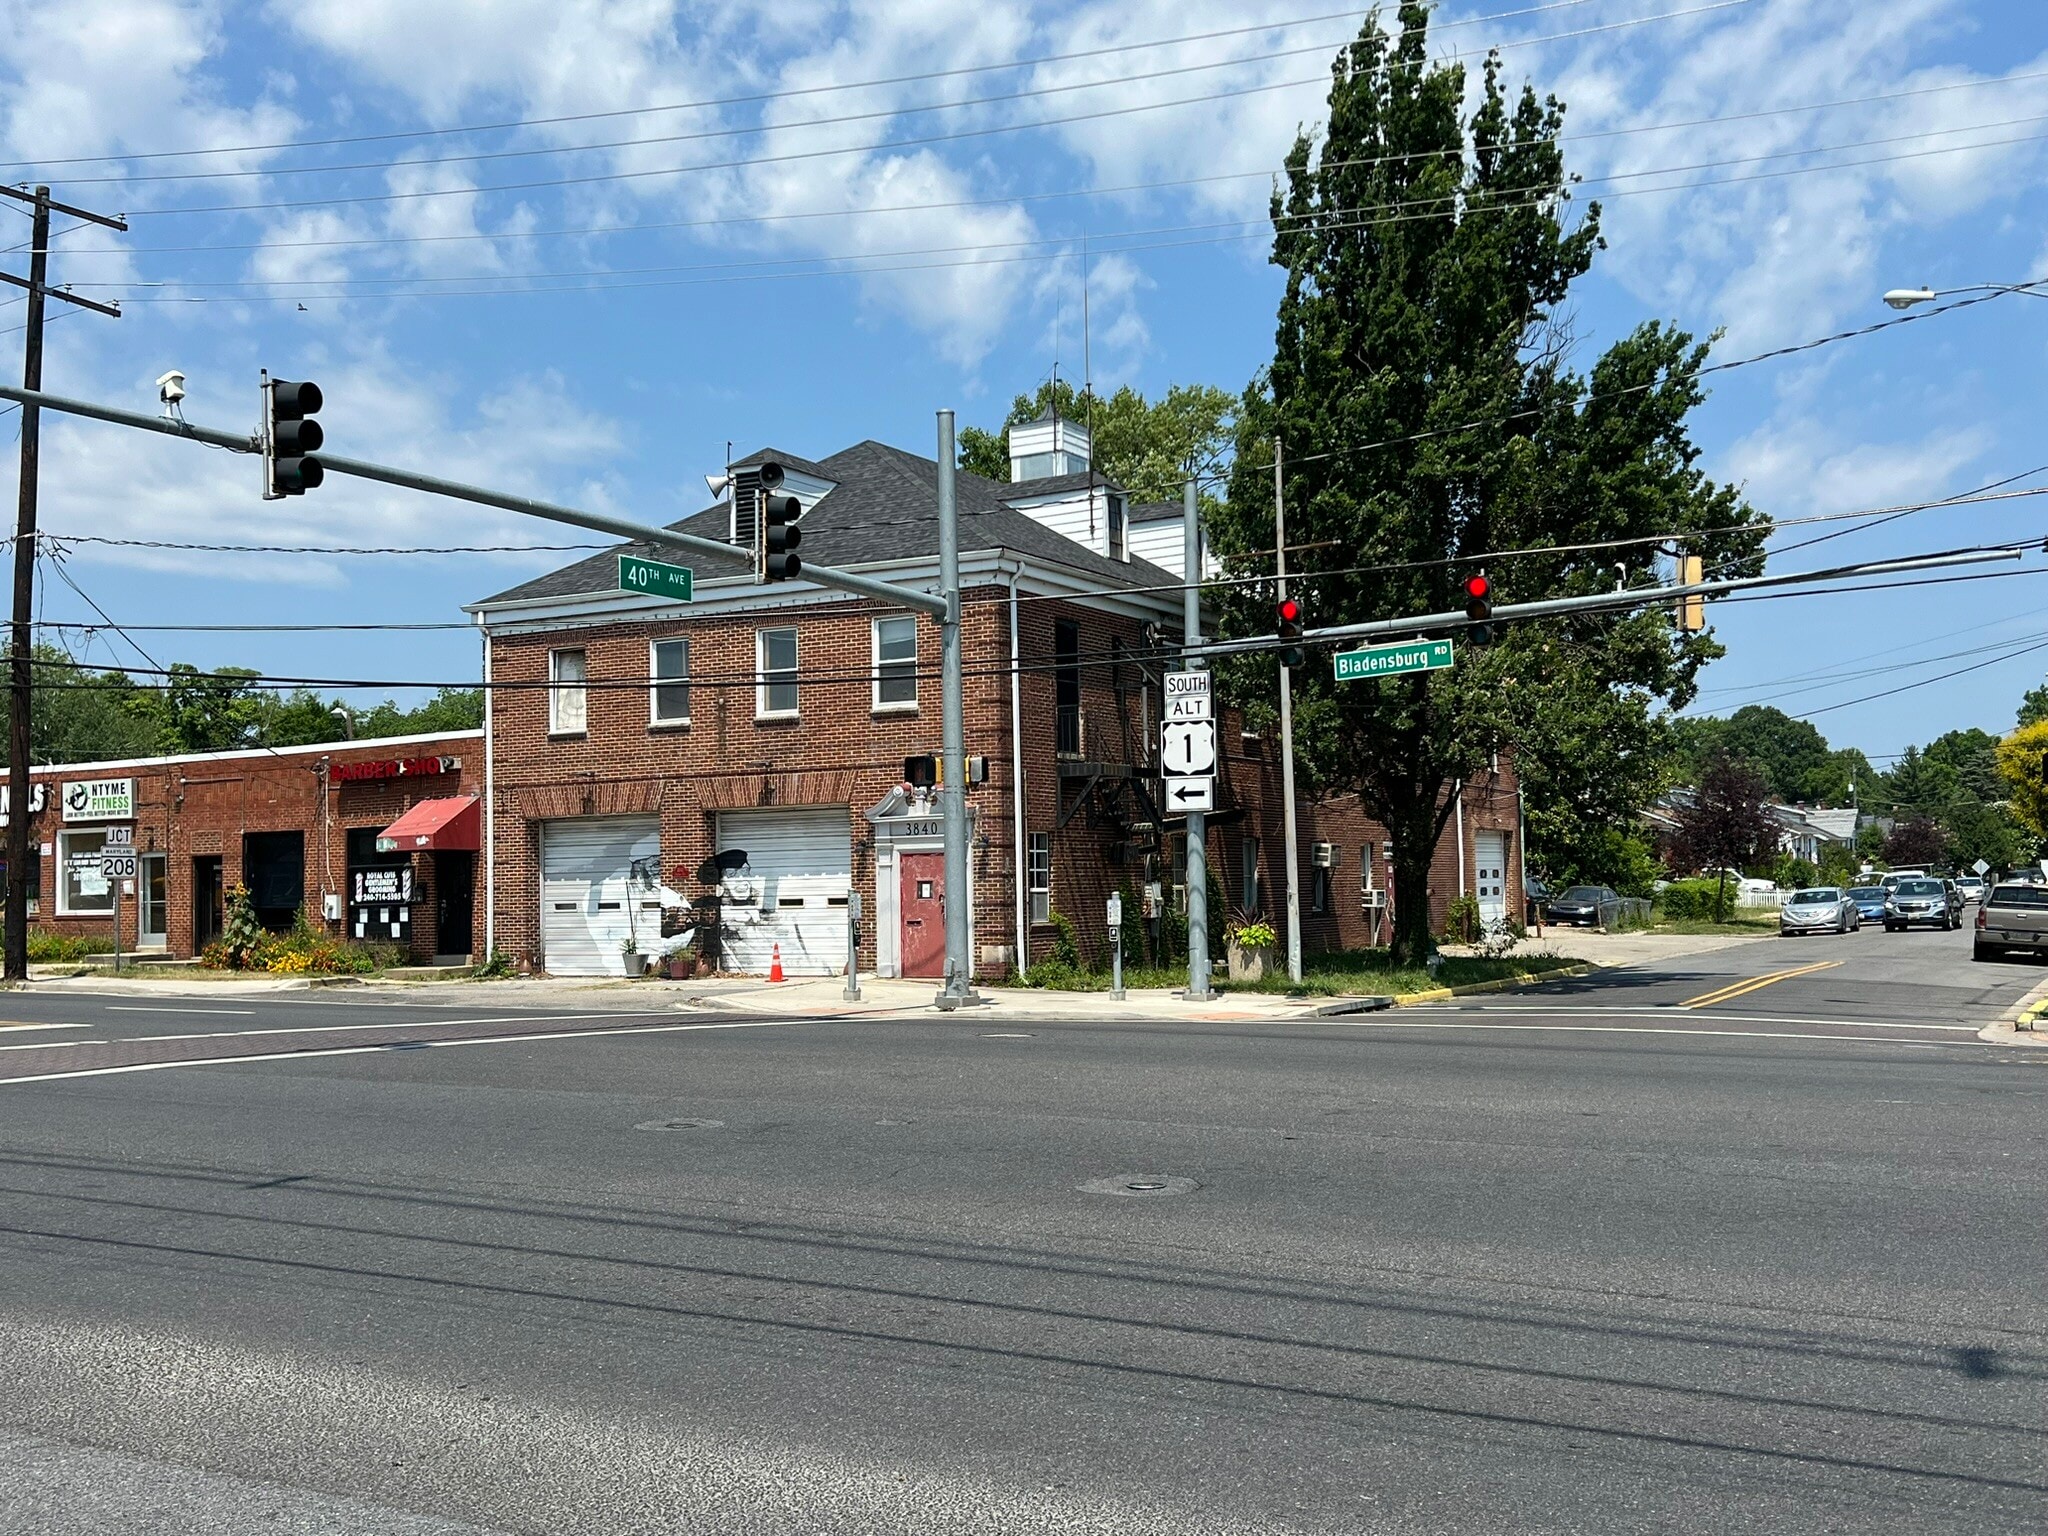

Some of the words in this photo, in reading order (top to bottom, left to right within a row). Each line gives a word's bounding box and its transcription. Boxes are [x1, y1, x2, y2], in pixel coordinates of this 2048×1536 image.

[628, 565, 660, 586] 40TH
[668, 572, 685, 585] AVE
[1339, 651, 1428, 669] Bladensburg
[1434, 645, 1448, 655] RD
[1168, 676, 1207, 692] SOUTH
[1173, 700, 1203, 715] ALT
[1184, 734, 1191, 763] 1
[330, 760, 397, 781] BARBER
[92, 782, 126, 796] NTYME
[92, 796, 129, 810] FITNESS
[109, 829, 130, 842] JCT
[905, 822, 938, 836] 3840
[103, 858, 135, 876] 208
